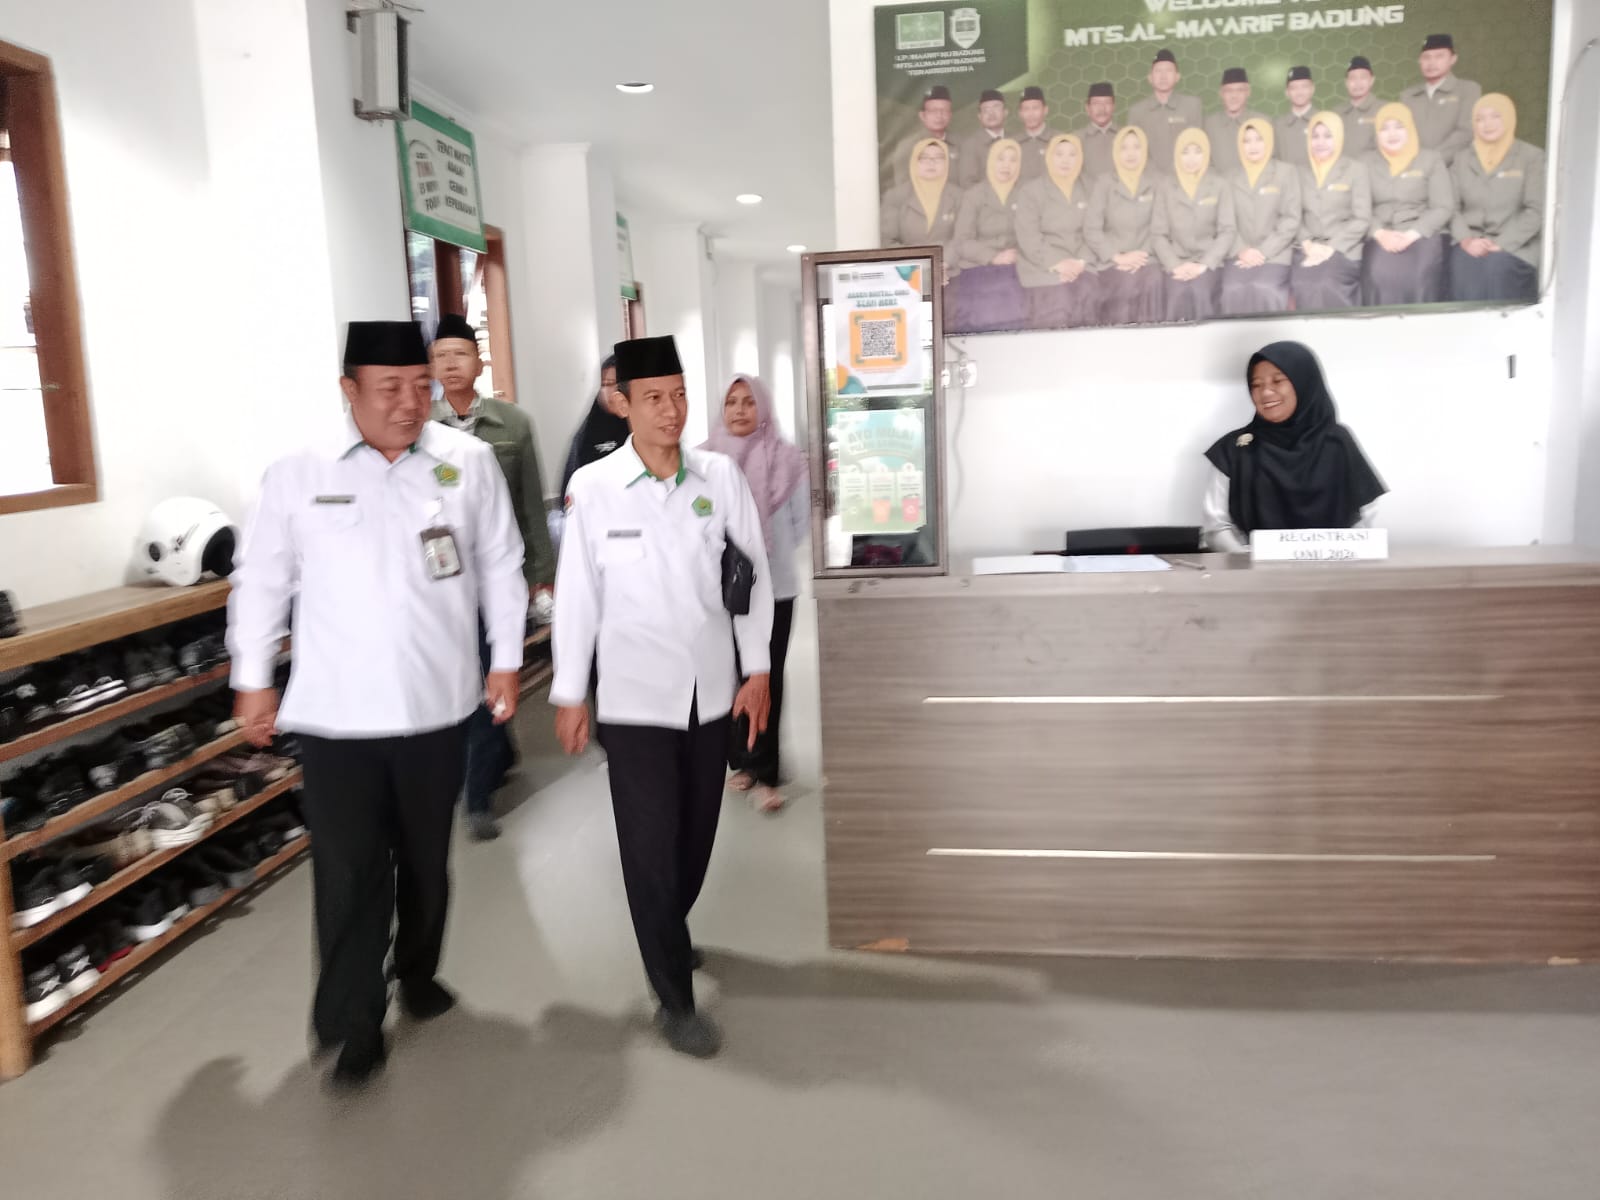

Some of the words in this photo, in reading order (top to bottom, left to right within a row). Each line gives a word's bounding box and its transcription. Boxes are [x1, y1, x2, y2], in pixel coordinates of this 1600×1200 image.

[1143, 0, 1282, 13] WELC
[1288, 4, 1405, 31] BADUNG
[1279, 530, 1369, 543] REGISTRASI
